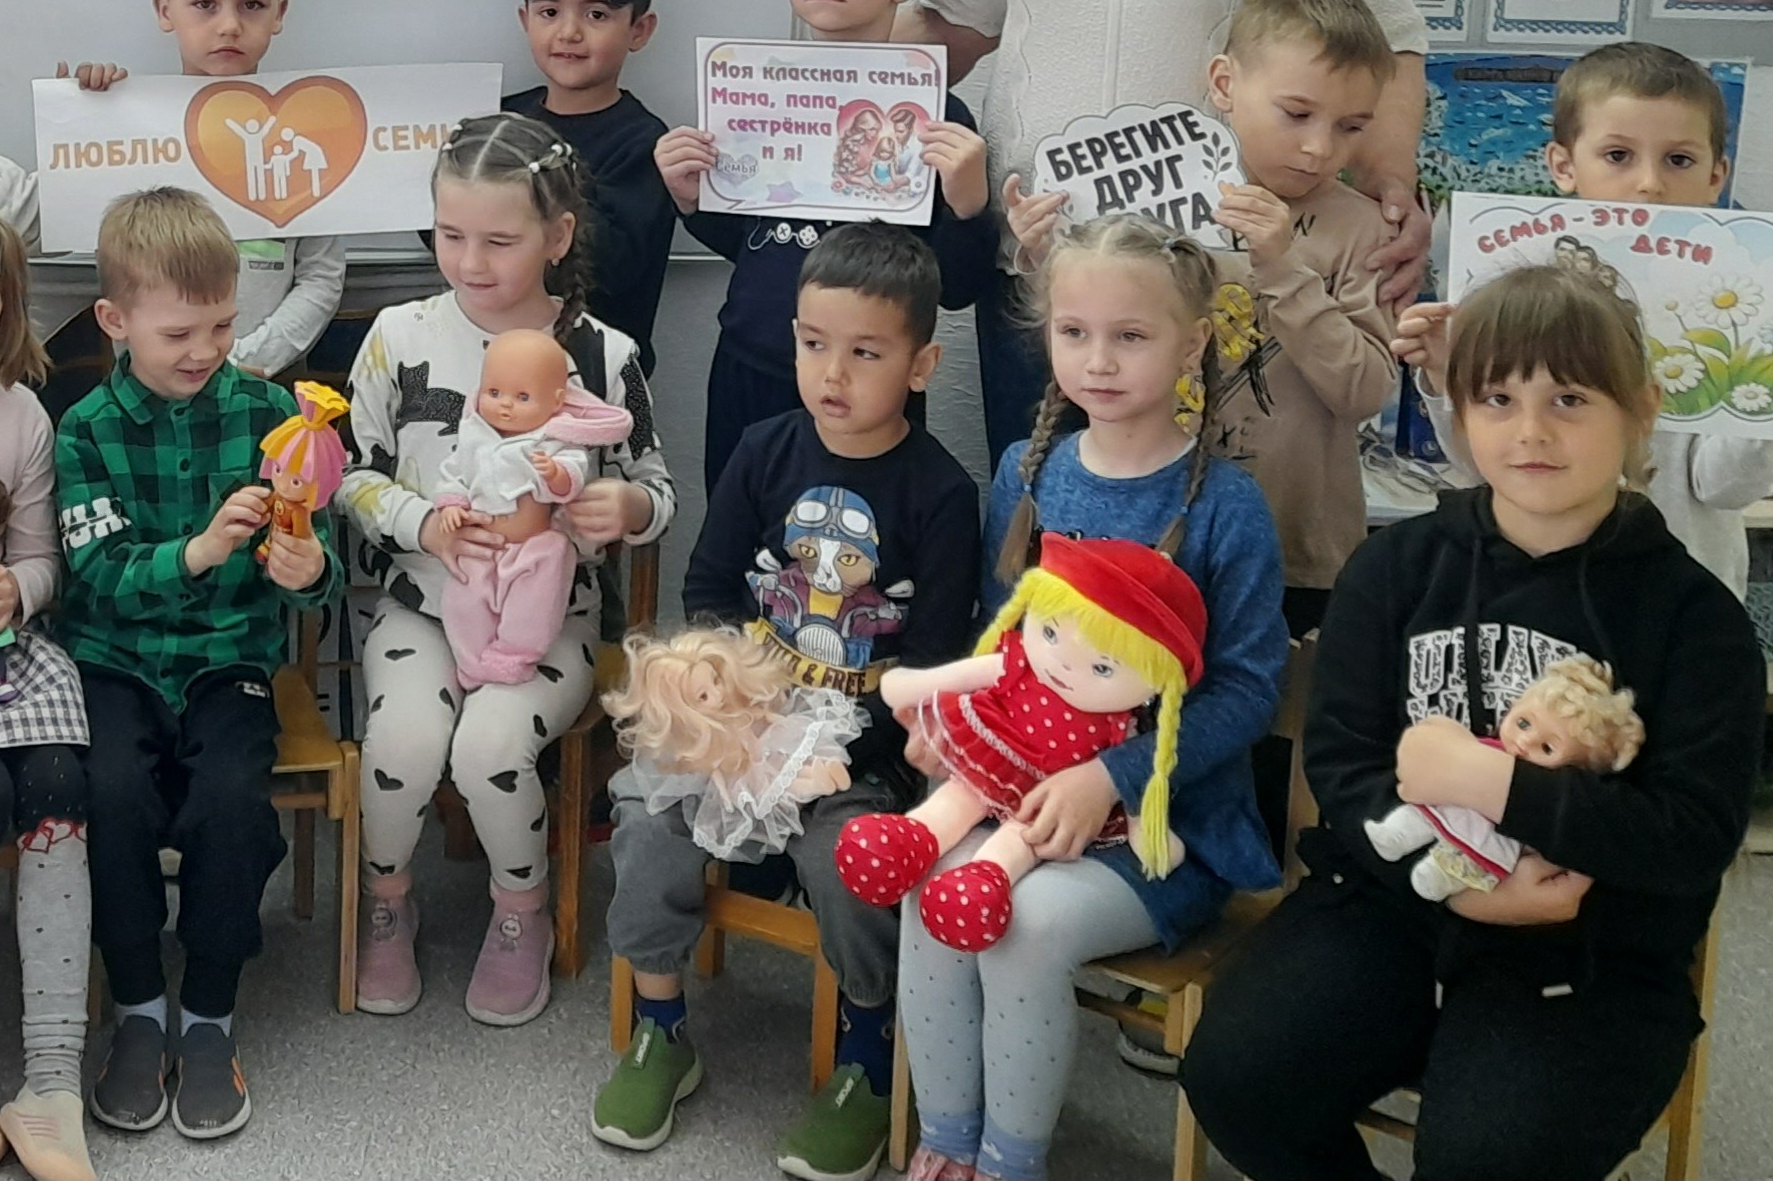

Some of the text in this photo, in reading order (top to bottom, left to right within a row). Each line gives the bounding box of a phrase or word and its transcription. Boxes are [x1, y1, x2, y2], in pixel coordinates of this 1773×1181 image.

[710, 61, 941, 87] Моя классная семья!
[711, 87, 845, 112] Мама, папа,
[727, 117, 832, 137] сестрёнка
[49, 136, 182, 171] ЛЮБЛЮ
[784, 144, 803, 162] я!
[1045, 109, 1208, 182] БЕРЕГИТЕ
[1093, 153, 1184, 216] ДРУГ
[1140, 192, 1217, 238] УГА
[1477, 213, 1567, 254] СЕМЬЯ
[1591, 207, 1651, 227] ЭТО
[1630, 234, 1714, 266] ДЕТИ
[822, 666, 867, 698] FREE
